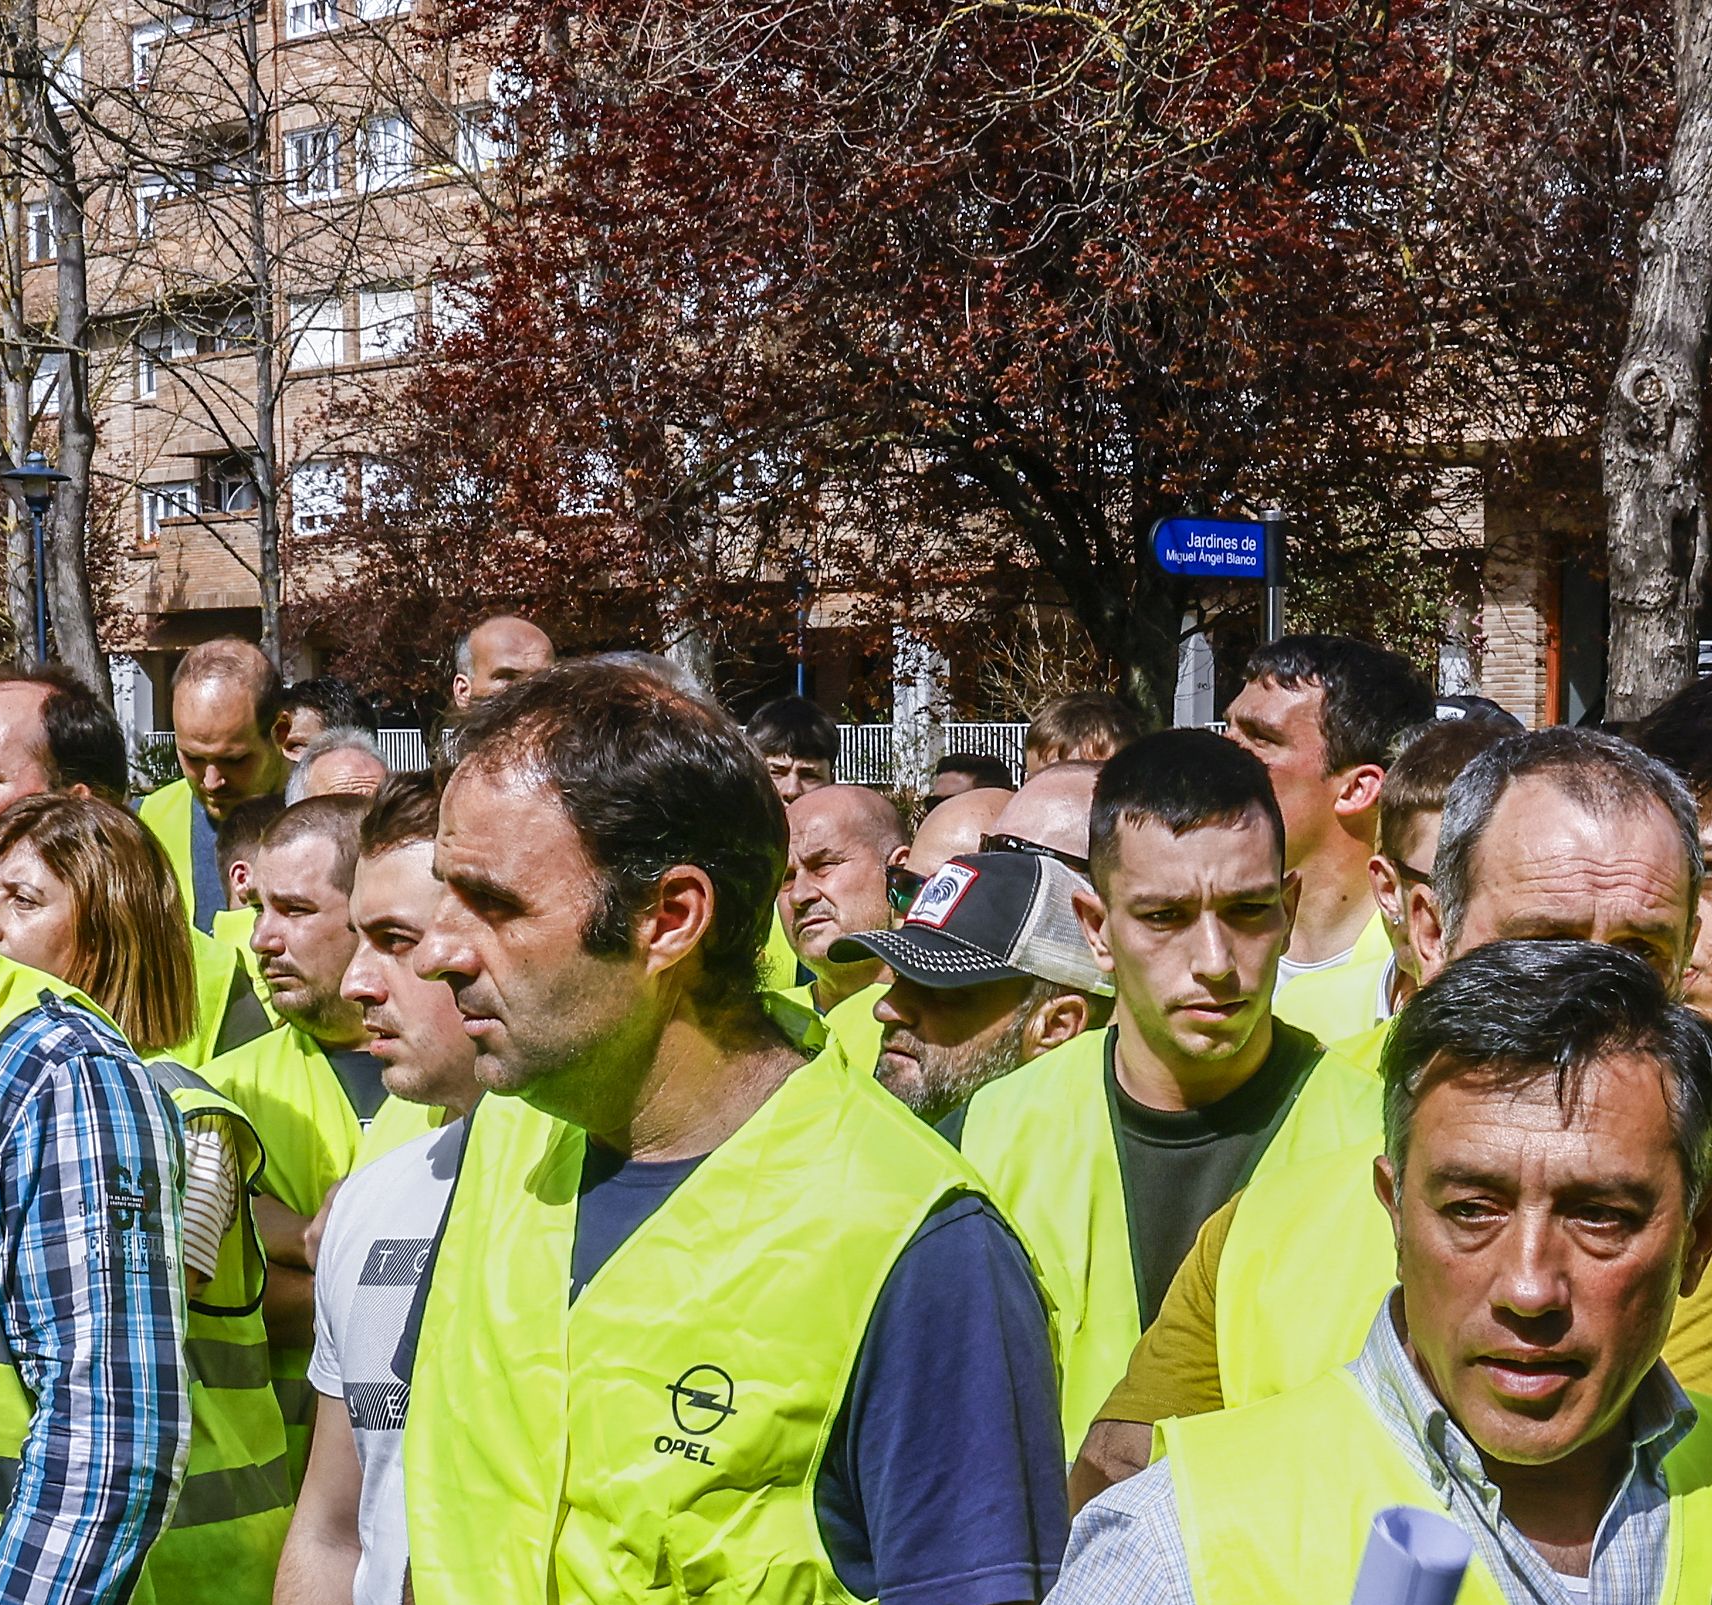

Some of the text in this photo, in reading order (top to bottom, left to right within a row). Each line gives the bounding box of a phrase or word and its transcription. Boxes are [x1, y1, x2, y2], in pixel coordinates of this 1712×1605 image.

[1186, 531, 1257, 551] Jardines de
[1166, 548, 1257, 566] Miguel Ángel Blanco
[654, 1435, 716, 1467] OPEL
